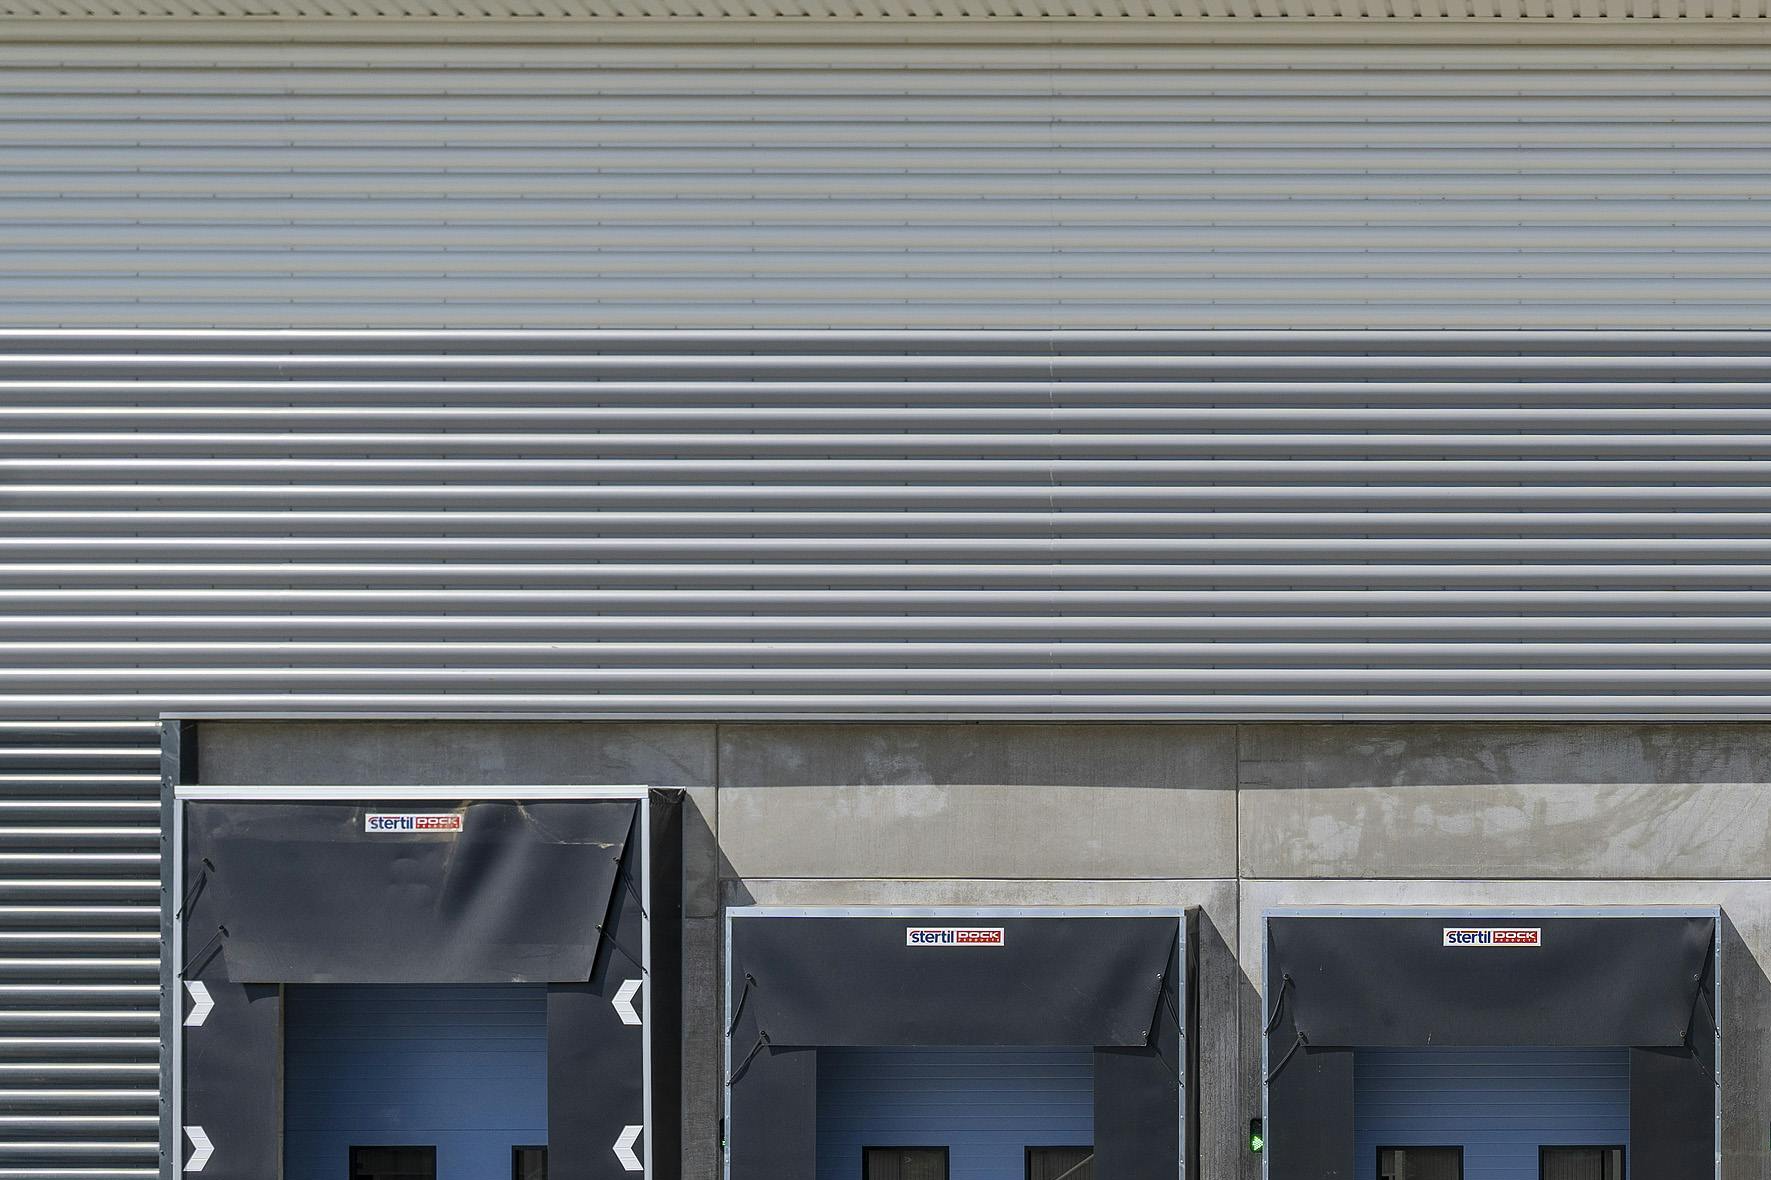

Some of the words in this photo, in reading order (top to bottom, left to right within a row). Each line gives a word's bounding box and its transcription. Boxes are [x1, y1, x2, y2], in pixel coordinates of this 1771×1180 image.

[369, 817, 413, 829] stertil
[911, 931, 954, 943] stertil
[1448, 931, 1491, 943] stertil
